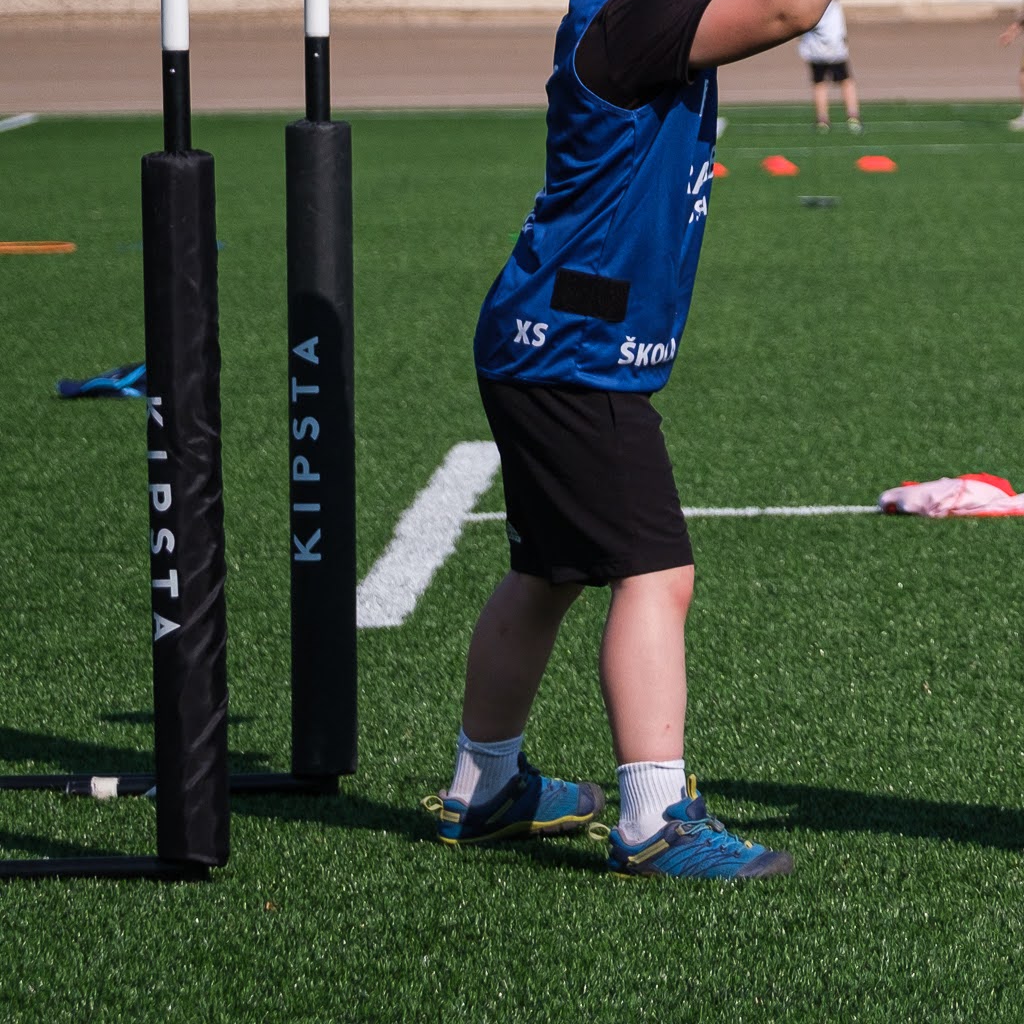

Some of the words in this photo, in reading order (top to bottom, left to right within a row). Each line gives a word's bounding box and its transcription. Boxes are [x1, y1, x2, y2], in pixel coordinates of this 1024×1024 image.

[513, 318, 549, 348] XS
[147, 396, 182, 642] KIPSTA
[292, 335, 322, 562] KIPSTA
